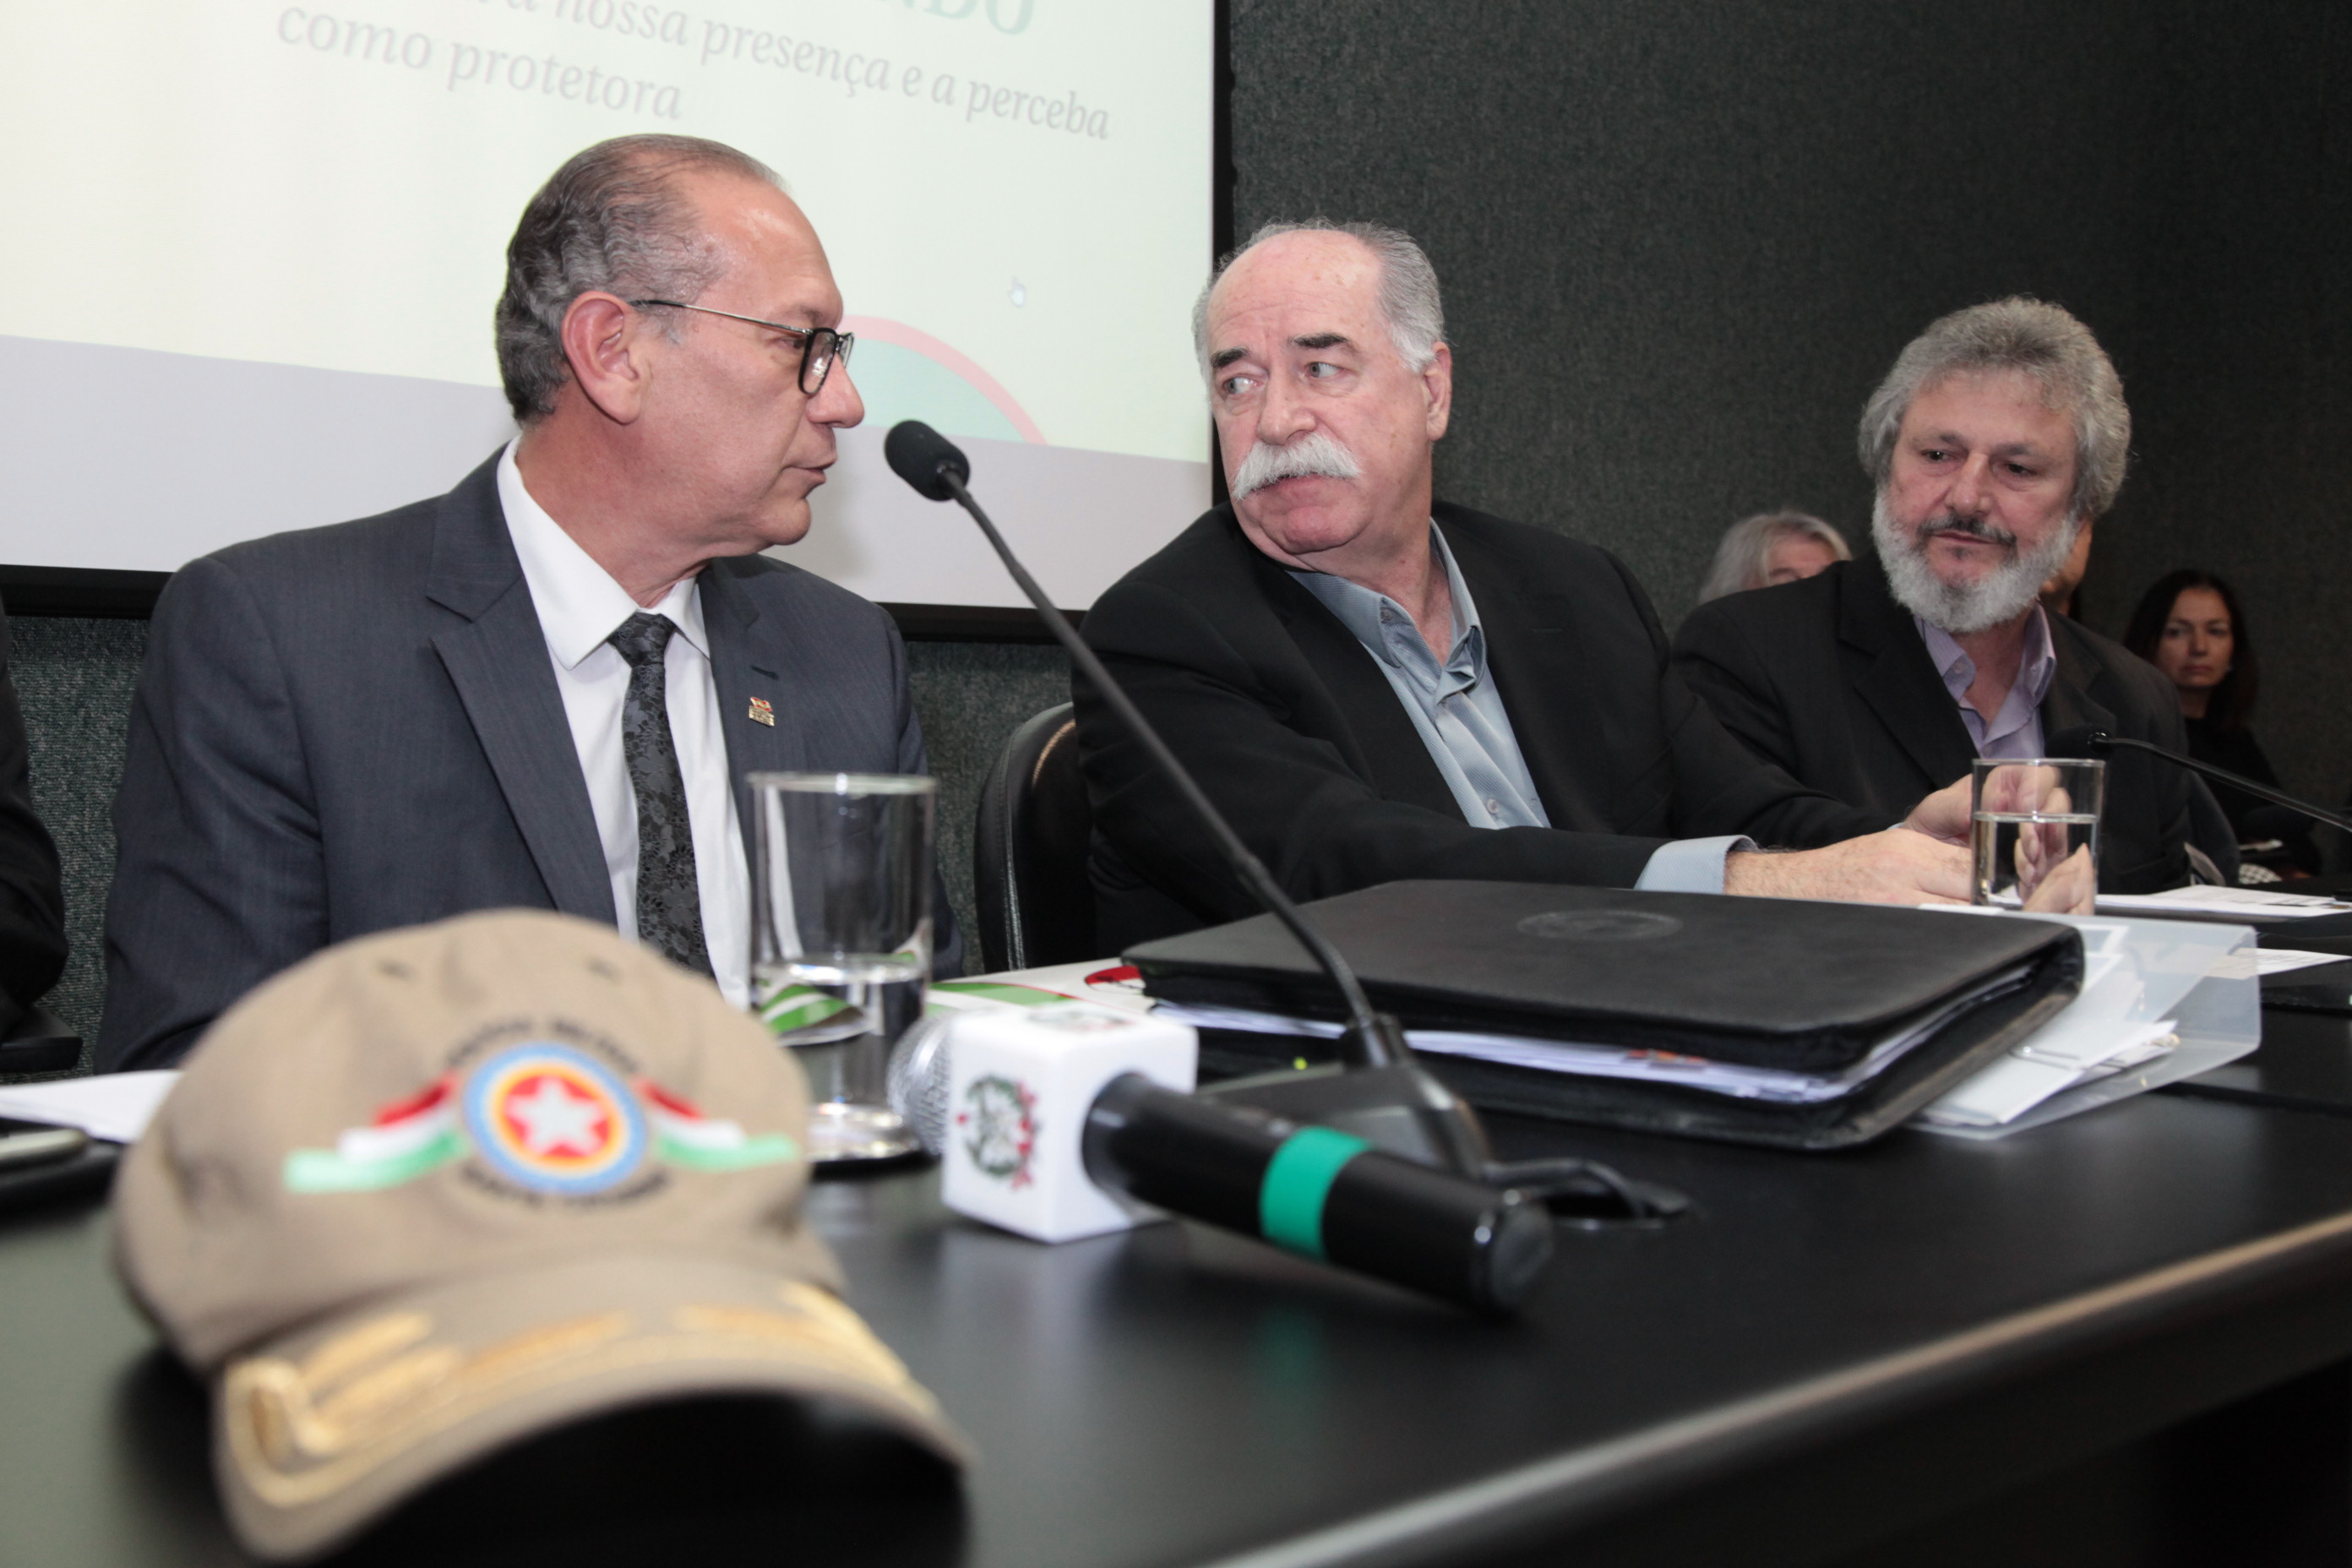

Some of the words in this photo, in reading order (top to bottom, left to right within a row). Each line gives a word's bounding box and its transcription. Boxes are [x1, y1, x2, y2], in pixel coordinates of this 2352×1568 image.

[277, 6, 432, 69] como
[446, 41, 682, 118] protetora
[700, 19, 890, 98] presença
[901, 65, 923, 97] e
[931, 73, 956, 106] a
[965, 80, 1110, 140] perceba
